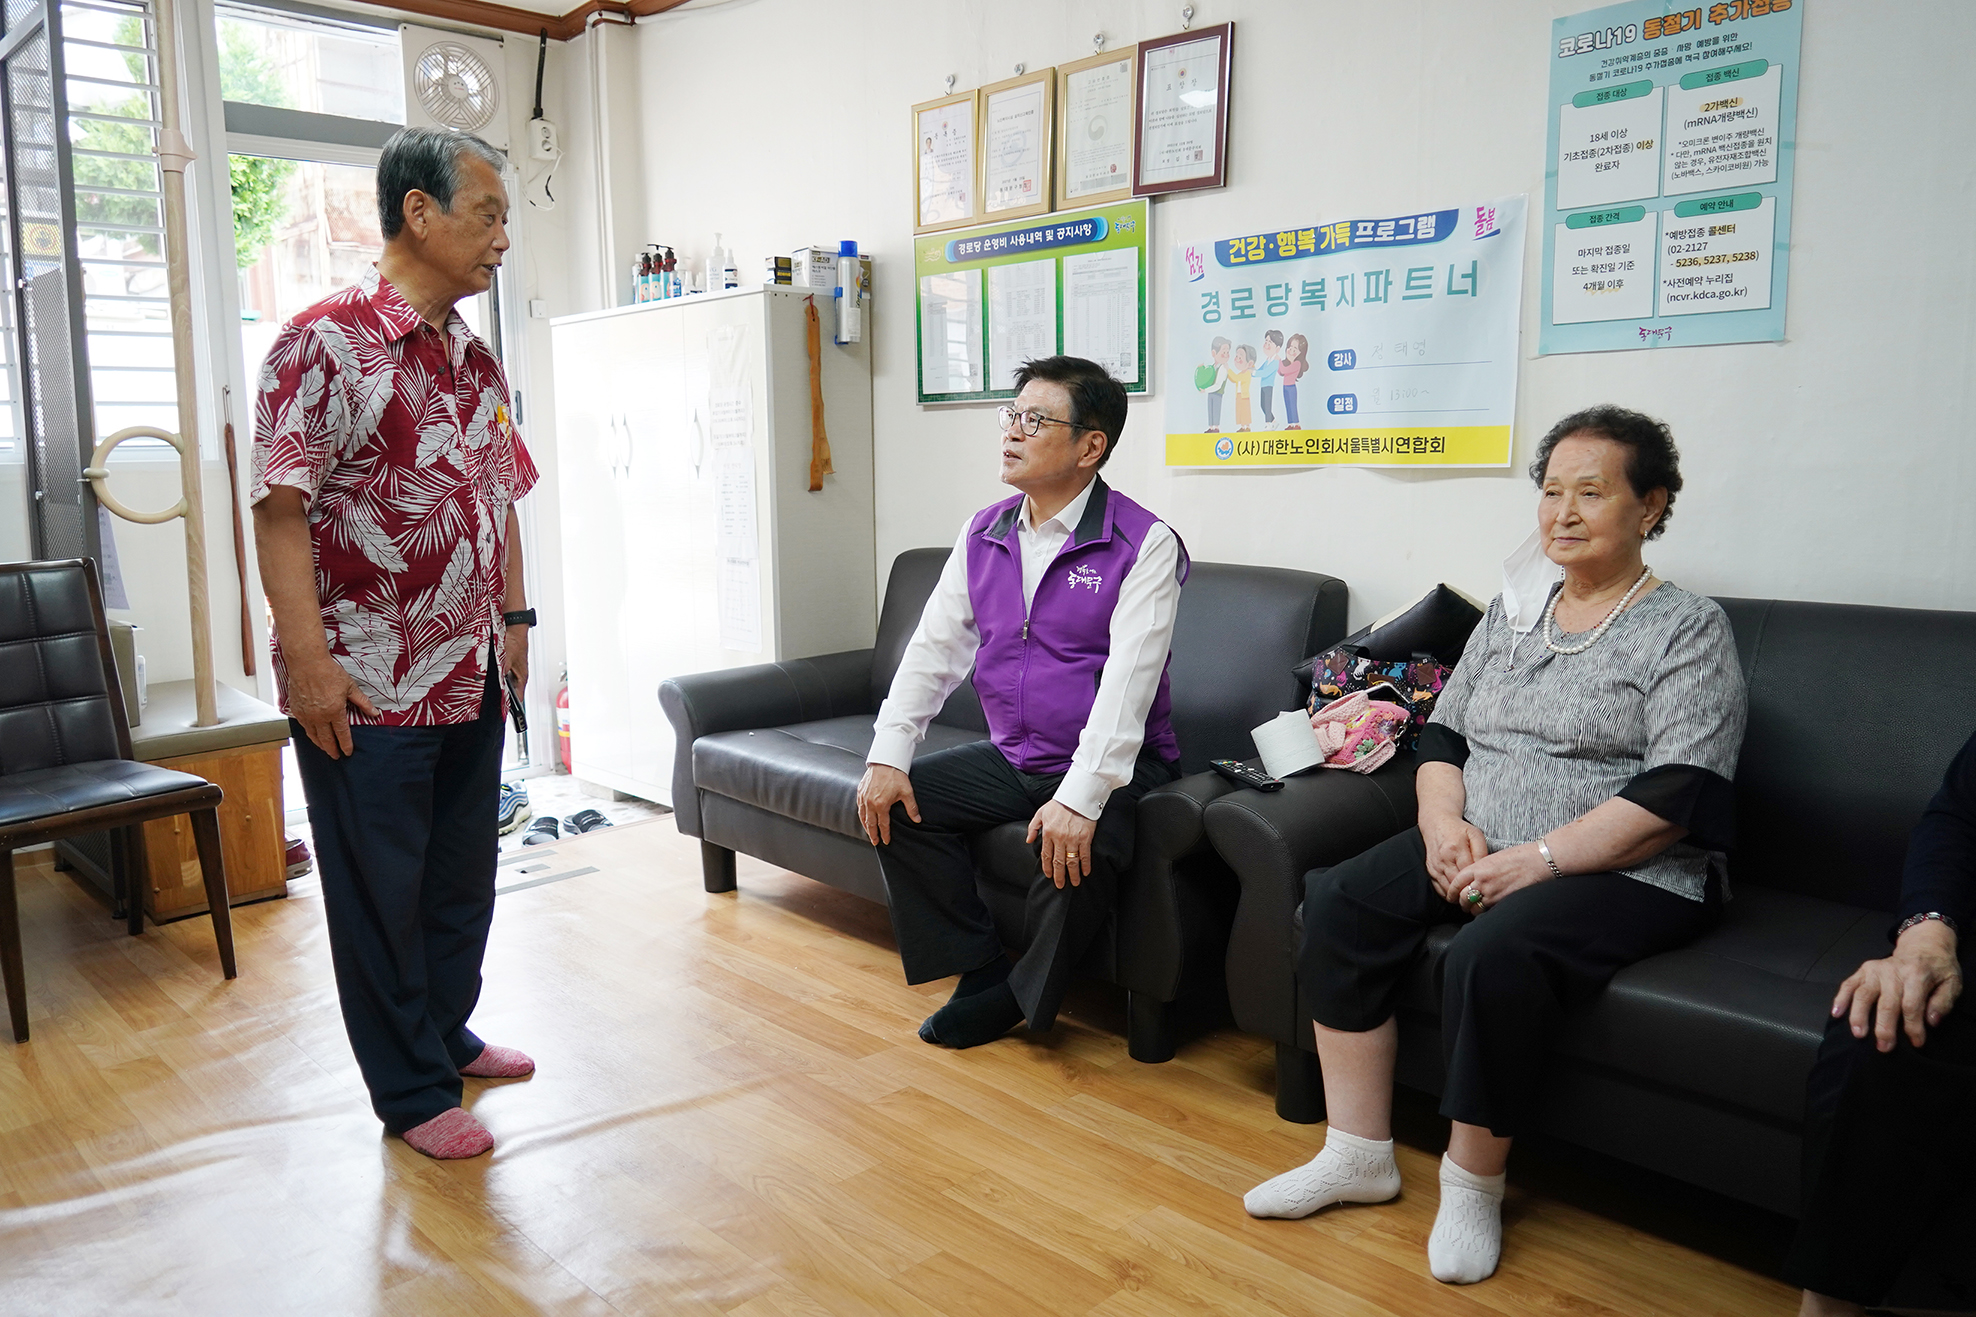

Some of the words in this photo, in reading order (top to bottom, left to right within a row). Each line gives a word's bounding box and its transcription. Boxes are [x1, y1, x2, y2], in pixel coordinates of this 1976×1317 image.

[1558, 24, 1637, 58] 코로나19
[1643, 7, 1702, 40] 동절기
[1696, 36, 1720, 49] 예방을
[1722, 32, 1738, 43] 위한
[1589, 71, 1610, 82] 동절기
[1612, 64, 1643, 77] 코로나19
[1645, 56, 1682, 71] 추가접종에
[1685, 52, 1700, 62] 적극
[1702, 42, 1753, 59] 참여해주세요!
[1706, 73, 1721, 82] 접종
[1723, 68, 1740, 78] 백신
[1596, 91, 1610, 101] 접종
[1612, 88, 1627, 97] 대상
[1704, 97, 1738, 112] 2가백신
[1684, 107, 1758, 130] (mRNA개량백신)
[1590, 131, 1609, 143] 18세
[1610, 128, 1628, 139] 이상
[1735, 127, 1765, 139] 개량백신
[1564, 142, 1634, 161] 기초접종(2차접종)
[1636, 139, 1654, 151] 이상
[1694, 146, 1717, 156] mRNA
[1719, 139, 1755, 152] 백신접종을
[1757, 137, 1772, 147] 원치
[1674, 161, 1688, 169] 않는
[1690, 158, 1706, 167] 경우,
[1708, 148, 1767, 164] 유전자재조합백신
[1595, 160, 1620, 173] 완료자
[1671, 167, 1704, 180] (노바백스,
[1705, 160, 1752, 175] 스카이코비원)
[1754, 158, 1769, 168] 가능
[1700, 201, 1715, 211] 예약
[1717, 199, 1734, 209] 안내
[1474, 205, 1496, 237] 돌봄
[1589, 215, 1603, 224] 접종
[1605, 212, 1620, 221] 간격
[1320, 221, 1351, 249] 가득
[1354, 214, 1437, 243] 프로그램
[1708, 223, 1736, 236] 콜센터
[958, 242, 981, 255] 경로당
[983, 237, 1007, 251] 운영비
[1010, 231, 1043, 246] 사용내역
[1045, 229, 1053, 241] 및
[1057, 223, 1092, 240] 공지사항
[1578, 246, 1603, 258] 마지막
[1605, 243, 1631, 255] 접종일
[1667, 242, 1708, 255] (02-2127
[1675, 257, 1702, 268] 5236,
[1703, 254, 1730, 264] 5237,
[1732, 250, 1759, 262] 5238)
[1572, 265, 1589, 275] 또는
[1591, 262, 1616, 274] 확진일
[1618, 260, 1636, 271] 기준
[1583, 280, 1605, 291] 4개월
[1607, 278, 1624, 289] 이후
[1705, 273, 1734, 285] 누리집
[1200, 259, 1478, 324] 경로당복지파트너
[1666, 286, 1748, 303] (ncvr.kdca.go.kr)
[1333, 352, 1352, 368] 감사
[1333, 397, 1354, 412] 일정
